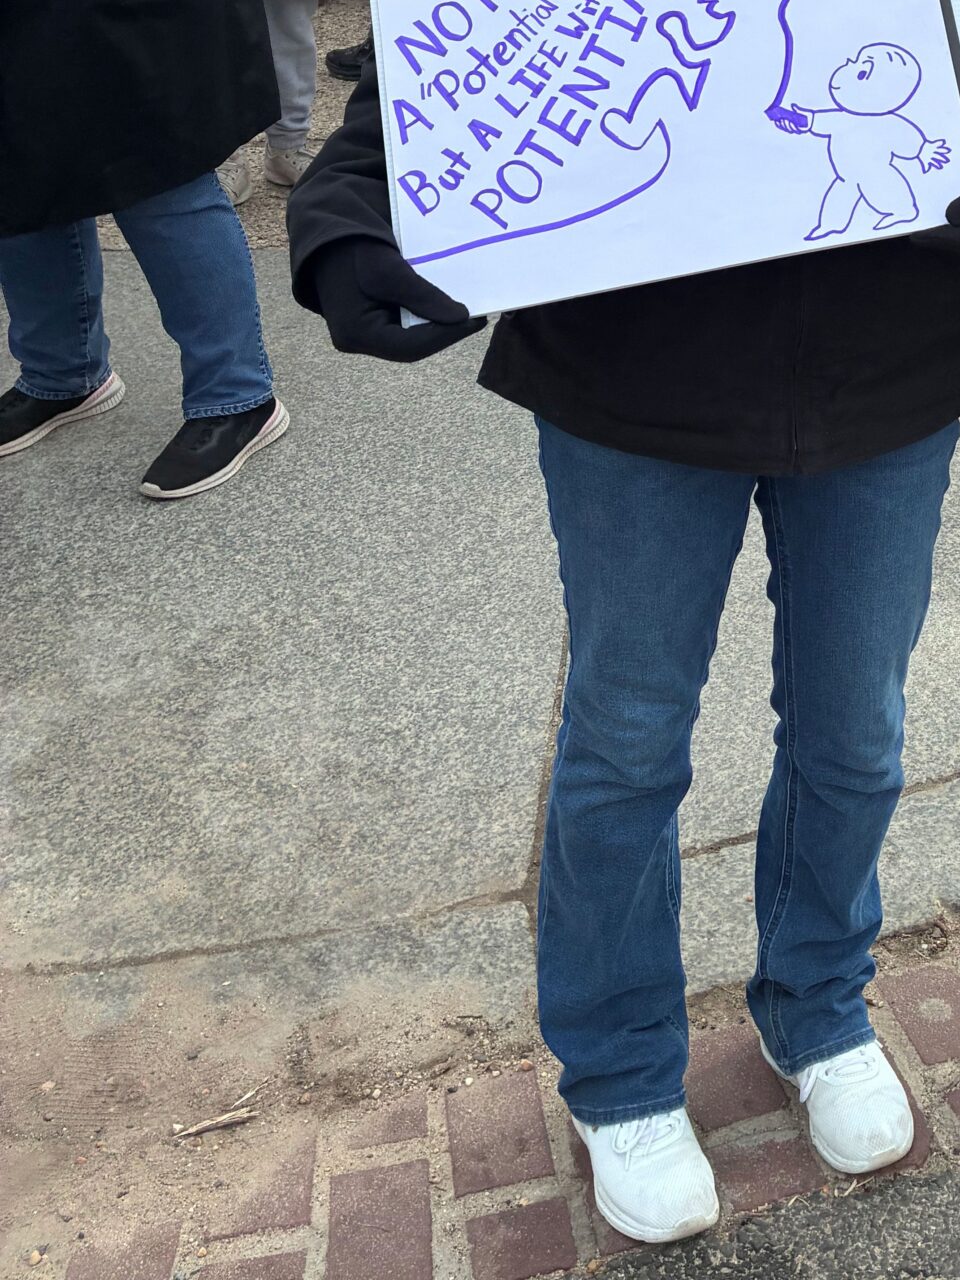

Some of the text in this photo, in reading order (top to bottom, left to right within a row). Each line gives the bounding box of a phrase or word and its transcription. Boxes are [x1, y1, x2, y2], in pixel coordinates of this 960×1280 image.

[392, 98, 435, 146] A
[397, 147, 472, 217] But
[467, 118, 503, 152] A
[494, 39, 569, 119] LIFE
